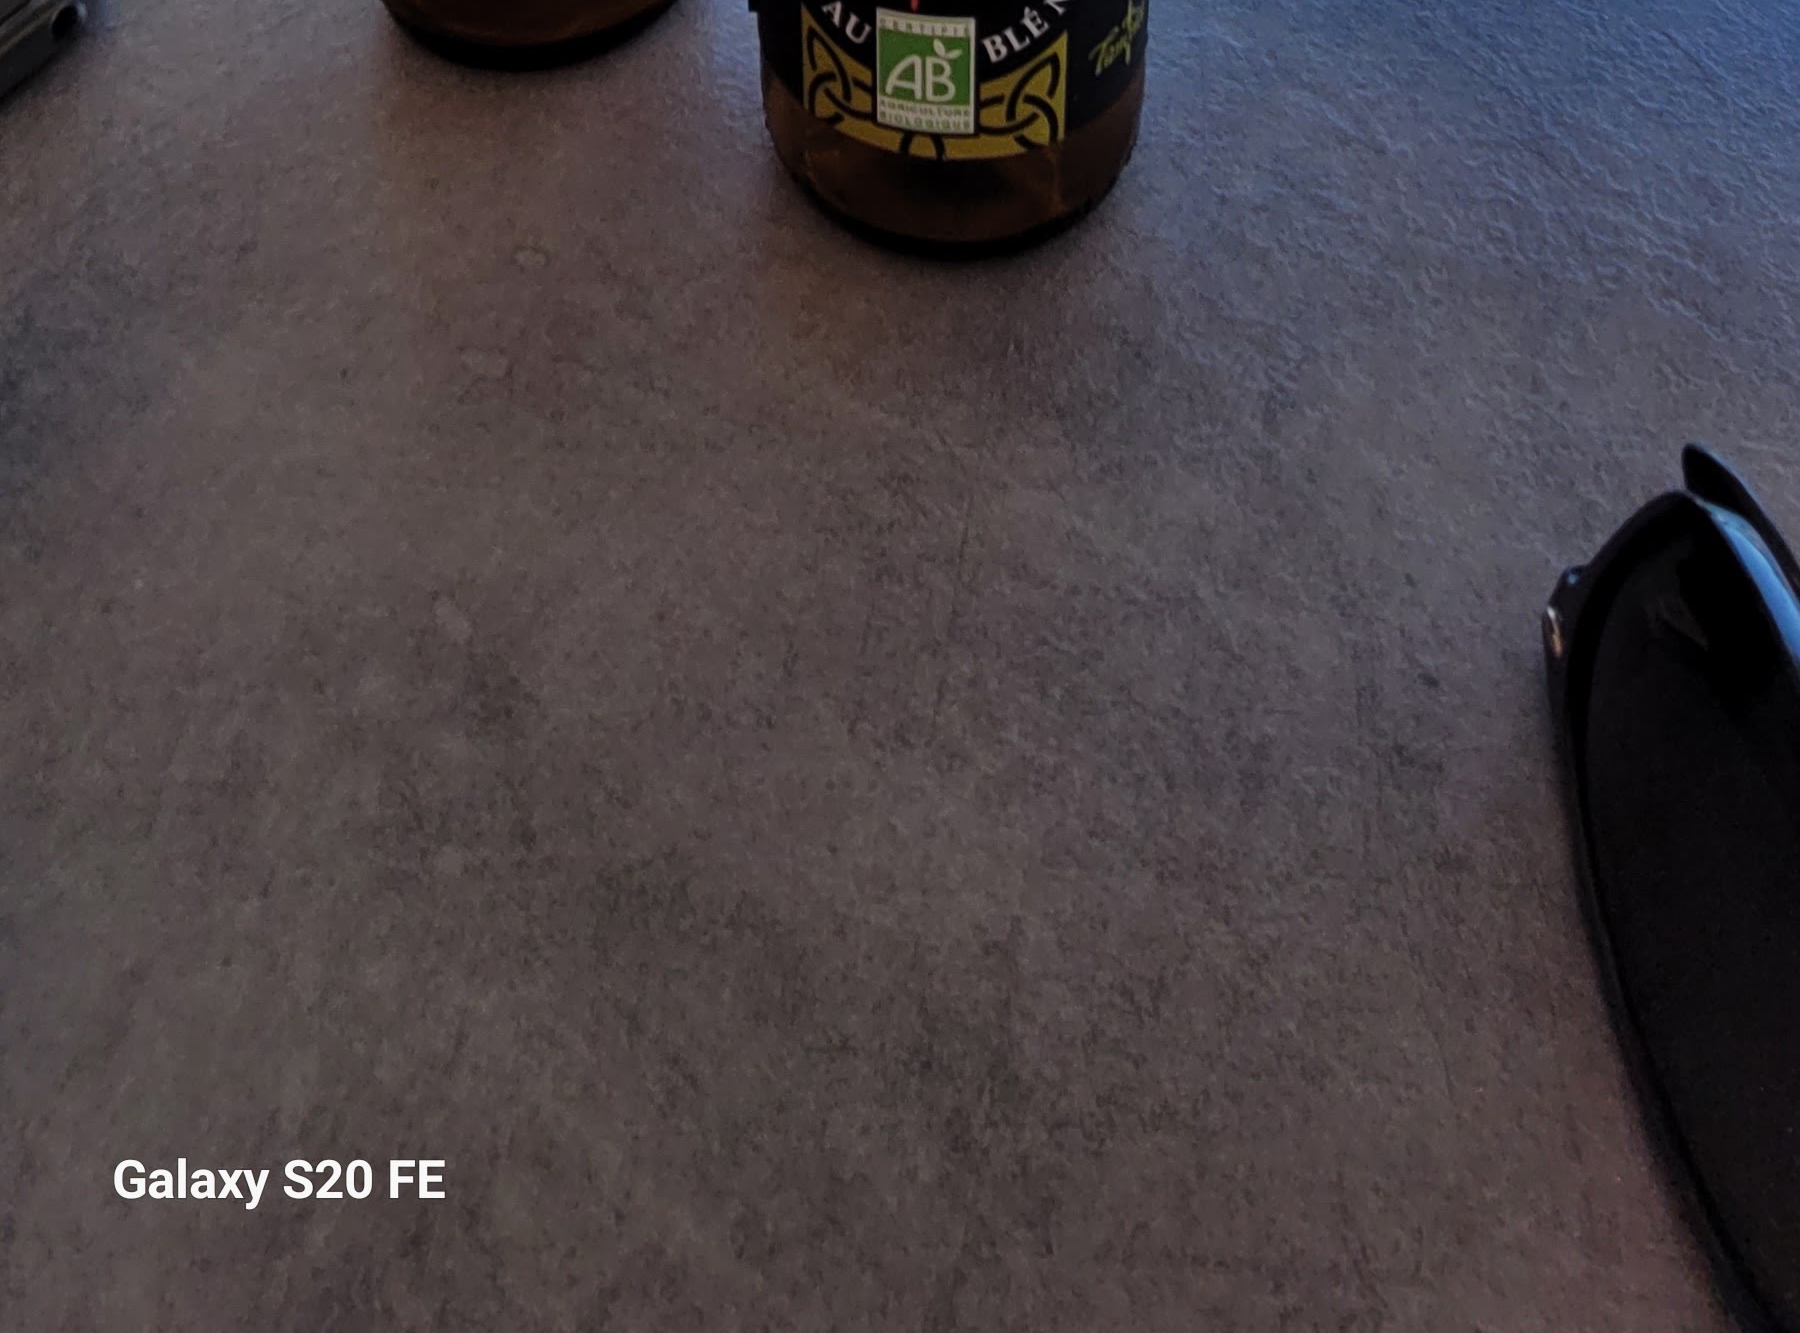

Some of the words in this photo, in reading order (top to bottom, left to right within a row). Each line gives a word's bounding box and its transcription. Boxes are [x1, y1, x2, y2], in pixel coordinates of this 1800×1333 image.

[822, 0, 872, 46] AU
[982, 8, 1052, 64] BLÉ
[885, 53, 957, 103] AB
